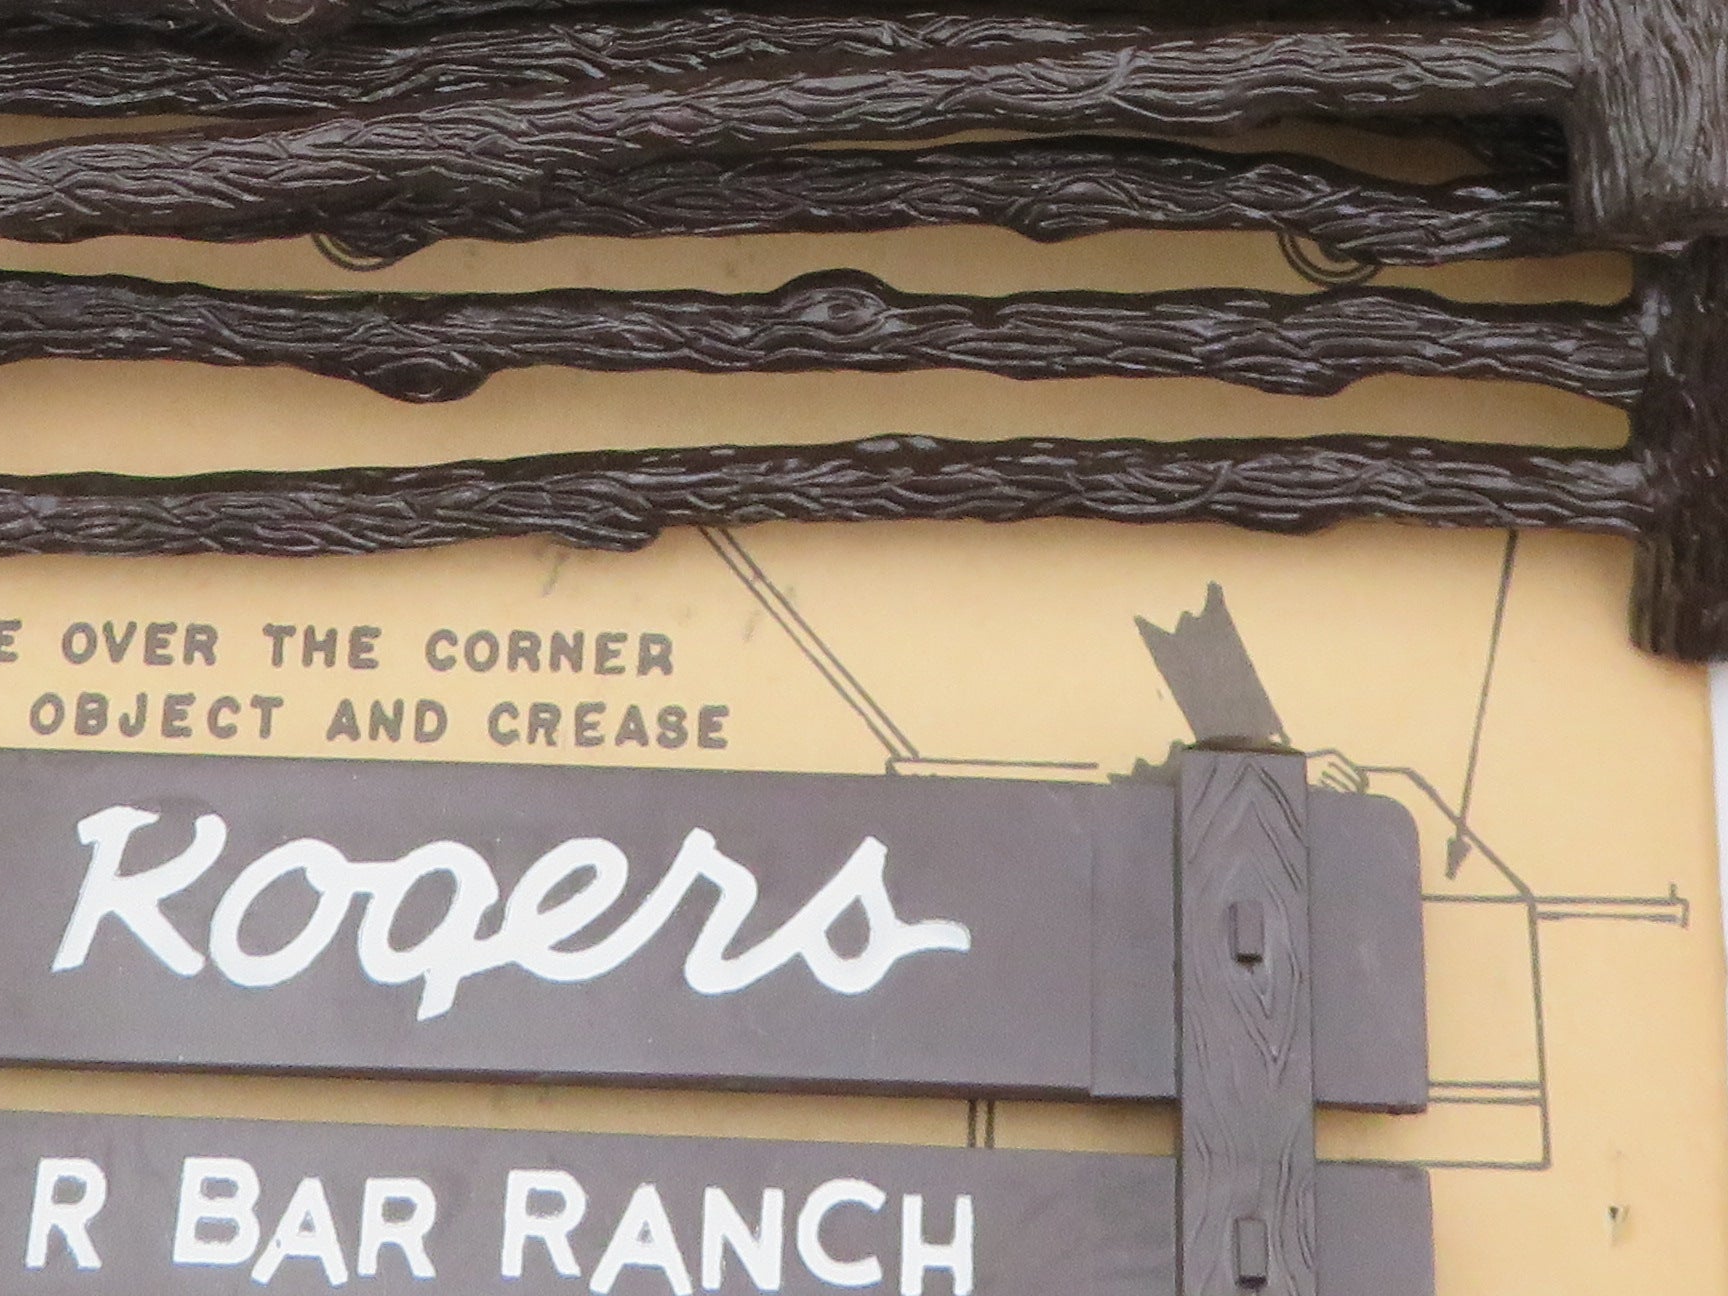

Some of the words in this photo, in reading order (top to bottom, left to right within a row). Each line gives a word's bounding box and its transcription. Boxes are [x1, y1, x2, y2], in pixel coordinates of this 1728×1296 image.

[62, 621, 217, 665] OVER
[263, 624, 381, 669] THE
[426, 630, 672, 675] CORNER
[31, 693, 283, 738] OBJECT
[327, 699, 447, 742] AND
[489, 702, 728, 748] CREASE
[53, 806, 970, 1021] Rogers
[26, 1158, 106, 1268] R
[173, 1157, 436, 1285] BAR
[501, 1170, 973, 1296] RANCH
